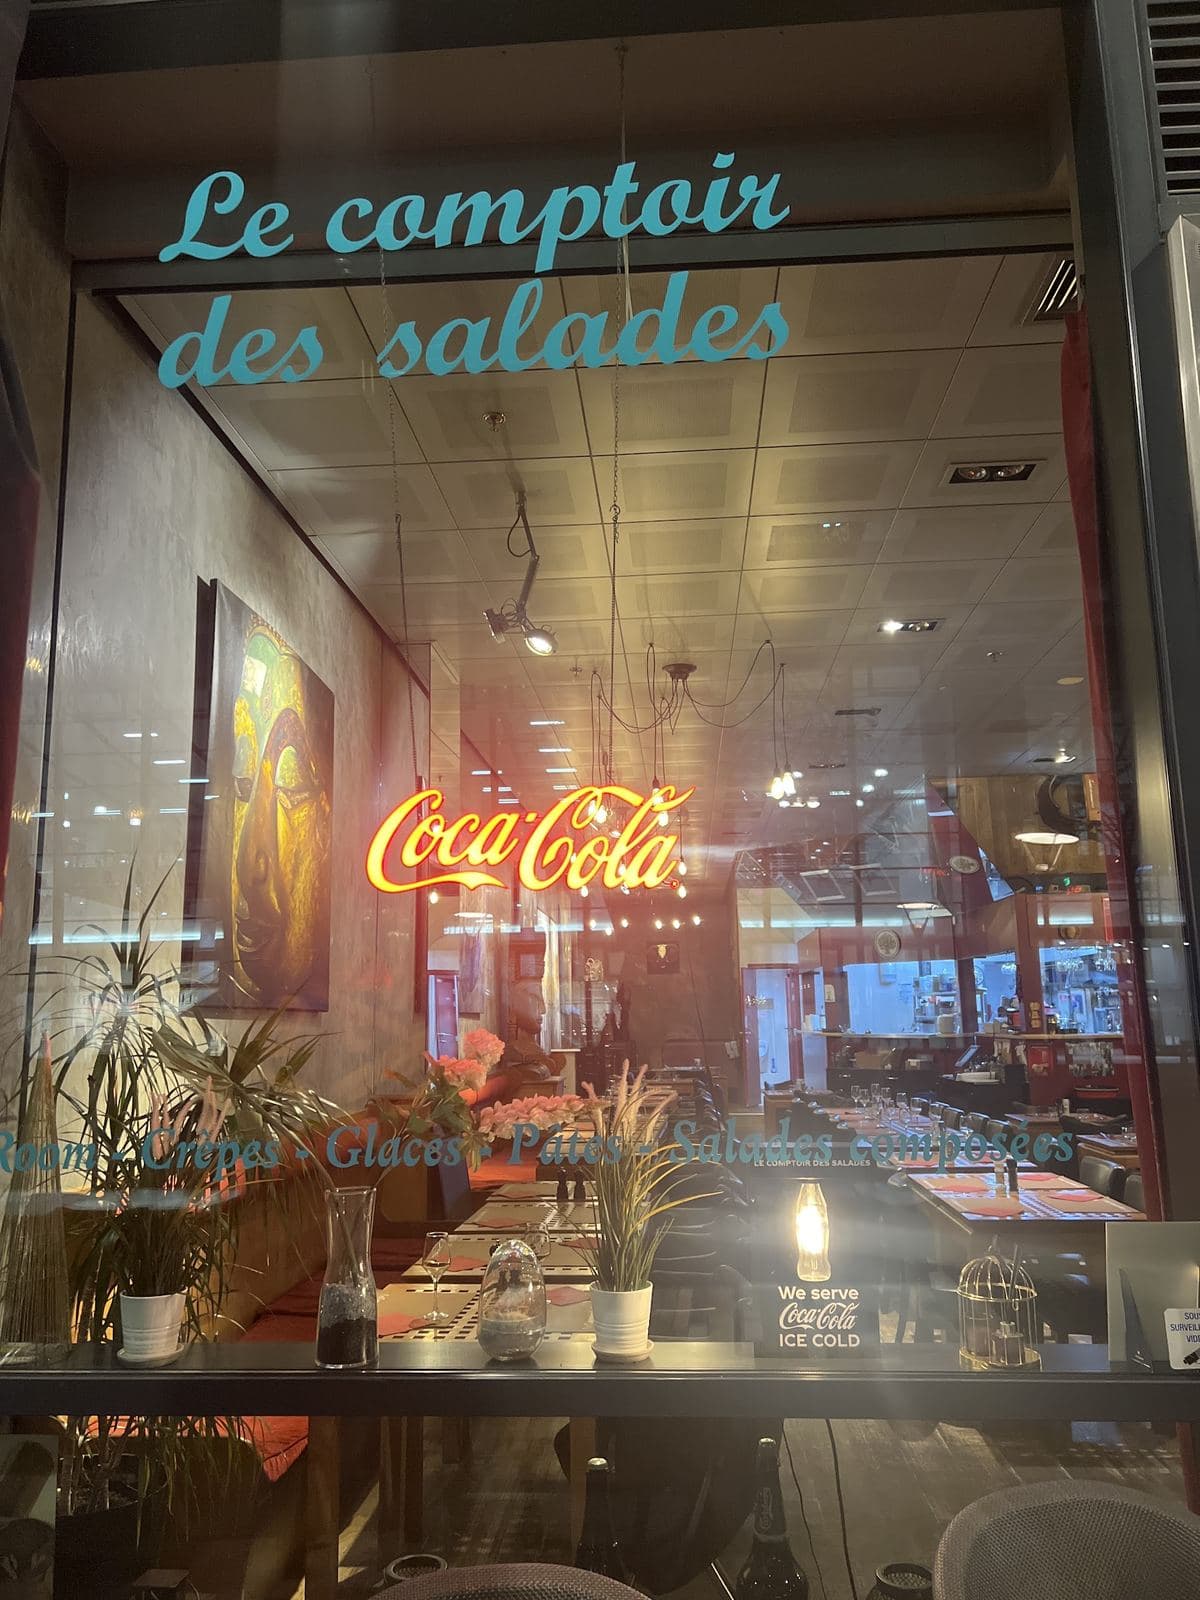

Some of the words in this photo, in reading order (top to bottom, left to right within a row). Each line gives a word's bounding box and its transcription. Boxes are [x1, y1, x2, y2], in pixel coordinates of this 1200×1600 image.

[158, 170, 293, 262] Le
[326, 152, 790, 273] comptoir
[158, 295, 323, 388] des
[377, 271, 789, 378] salades
[366, 785, 695, 893] Coca-Cola
[142, 1128, 281, 1181] Crêpes
[325, 1122, 464, 1168] Glaces
[506, 1122, 622, 1167] Pâtes
[669, 1116, 833, 1163] Salades
[849, 1119, 1073, 1175] composées
[754, 1159, 765, 1167] LE
[766, 1159, 811, 1167] COMPTOIR
[813, 1159, 830, 1167] DES
[832, 1159, 871, 1167] SALADES
[778, 1286, 806, 1300] We
[811, 1288, 859, 1300] serve
[779, 1302, 860, 1329] Coca-Cola
[780, 1334, 808, 1347] ICE
[812, 1334, 860, 1347] COLD
